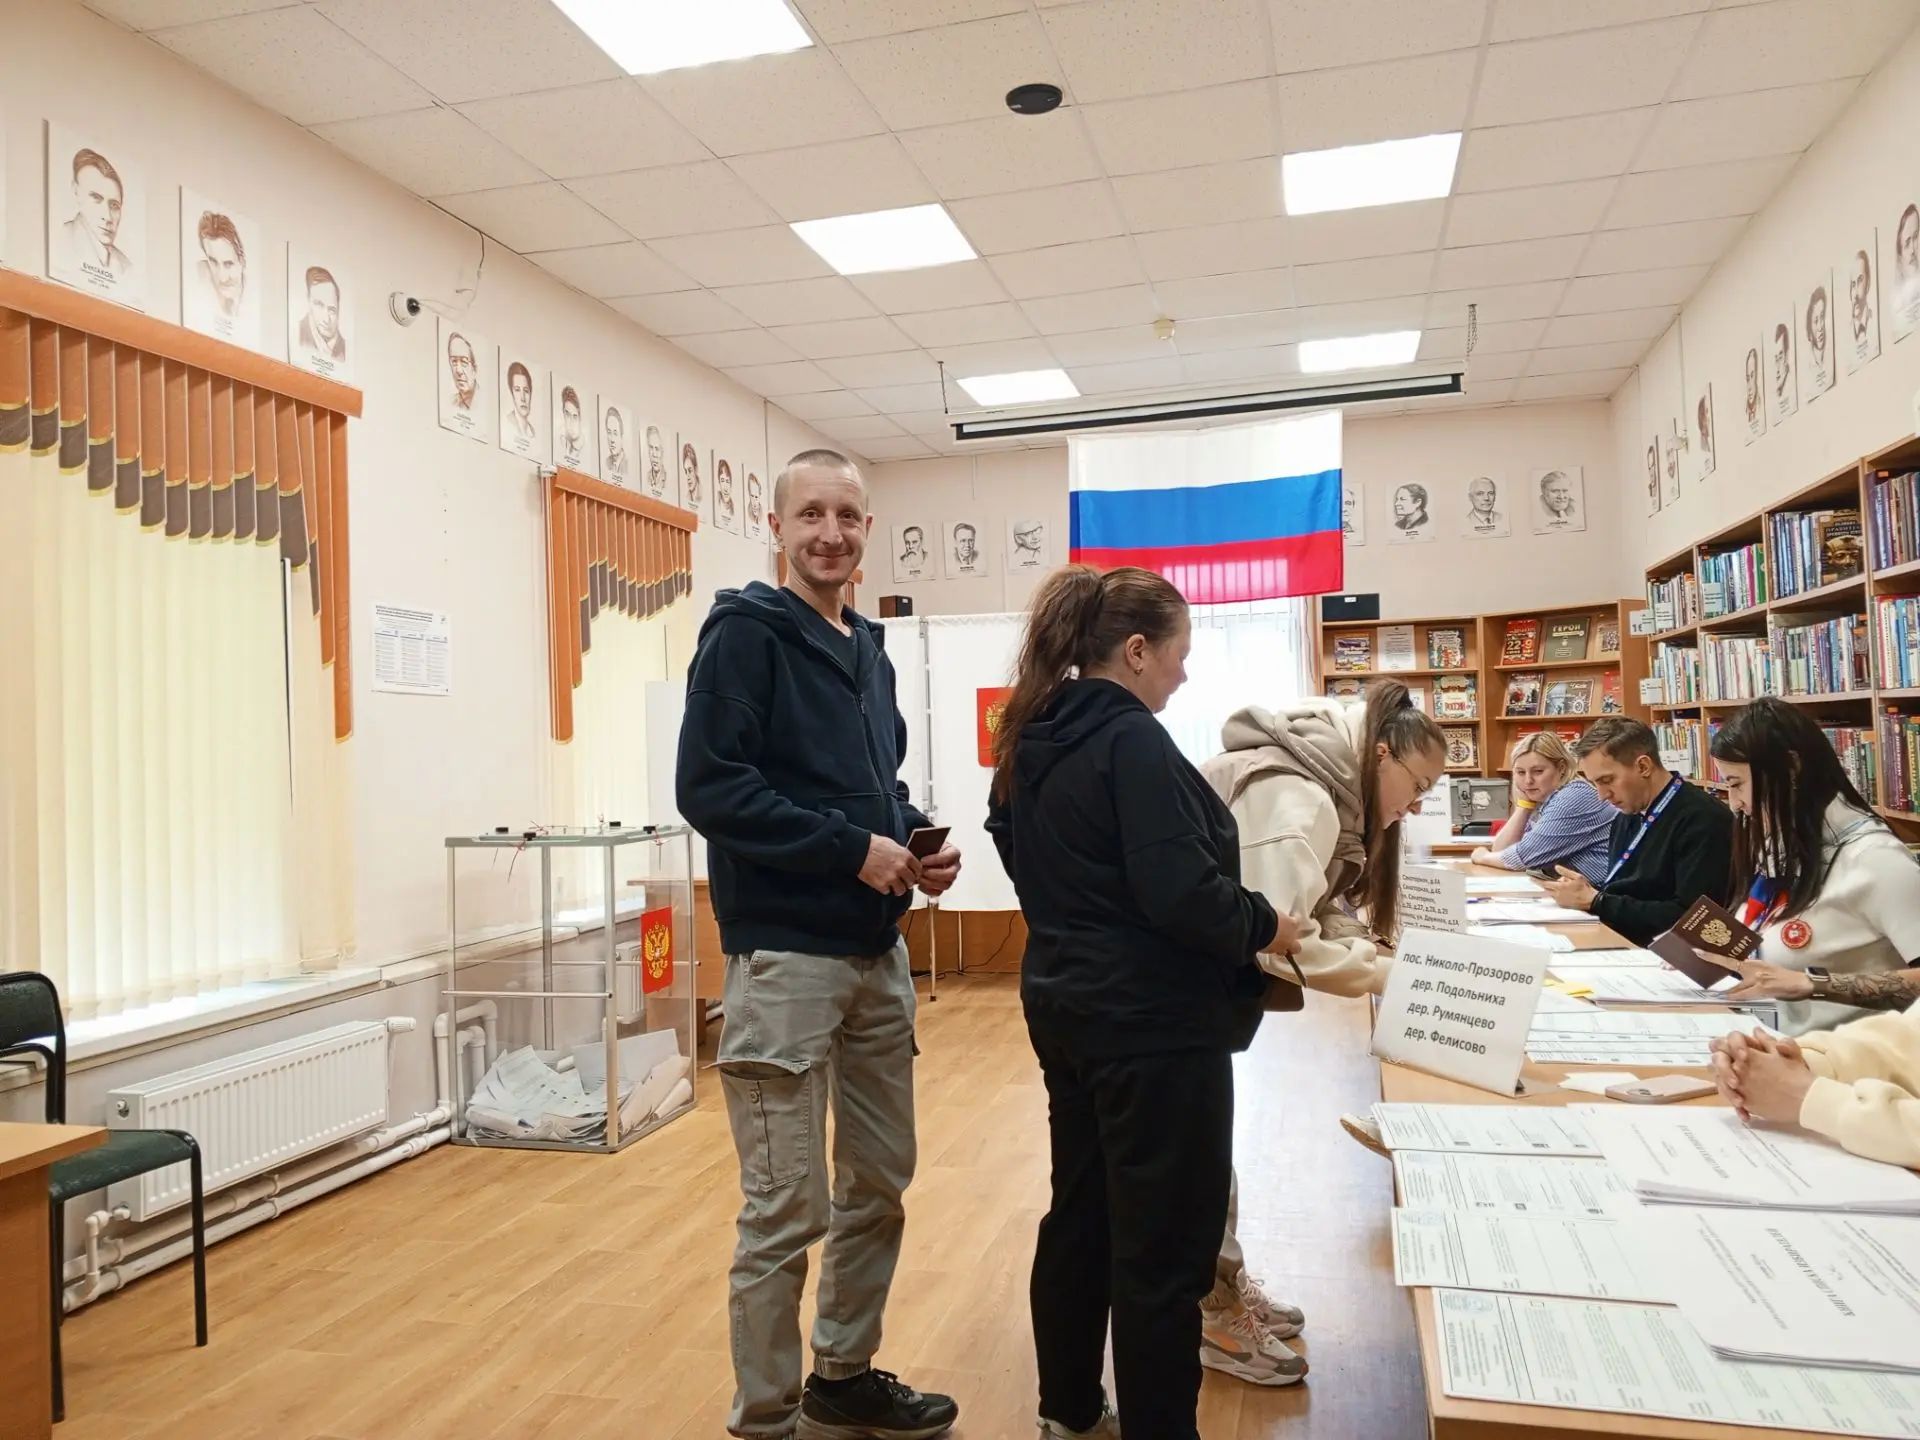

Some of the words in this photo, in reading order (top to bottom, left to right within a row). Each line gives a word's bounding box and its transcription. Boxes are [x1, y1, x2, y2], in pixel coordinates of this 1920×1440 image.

[1402, 952, 1423, 965] пос.
[1425, 955, 1534, 986] Николо-Прозорово
[1410, 978, 1433, 993] дер.
[1436, 981, 1506, 1006] Подольниха
[1406, 1001, 1429, 1017] дер.
[1432, 1006, 1496, 1031] Румянцево
[1403, 1025, 1427, 1042] дер.
[1430, 1030, 1487, 1055] Фелисово
